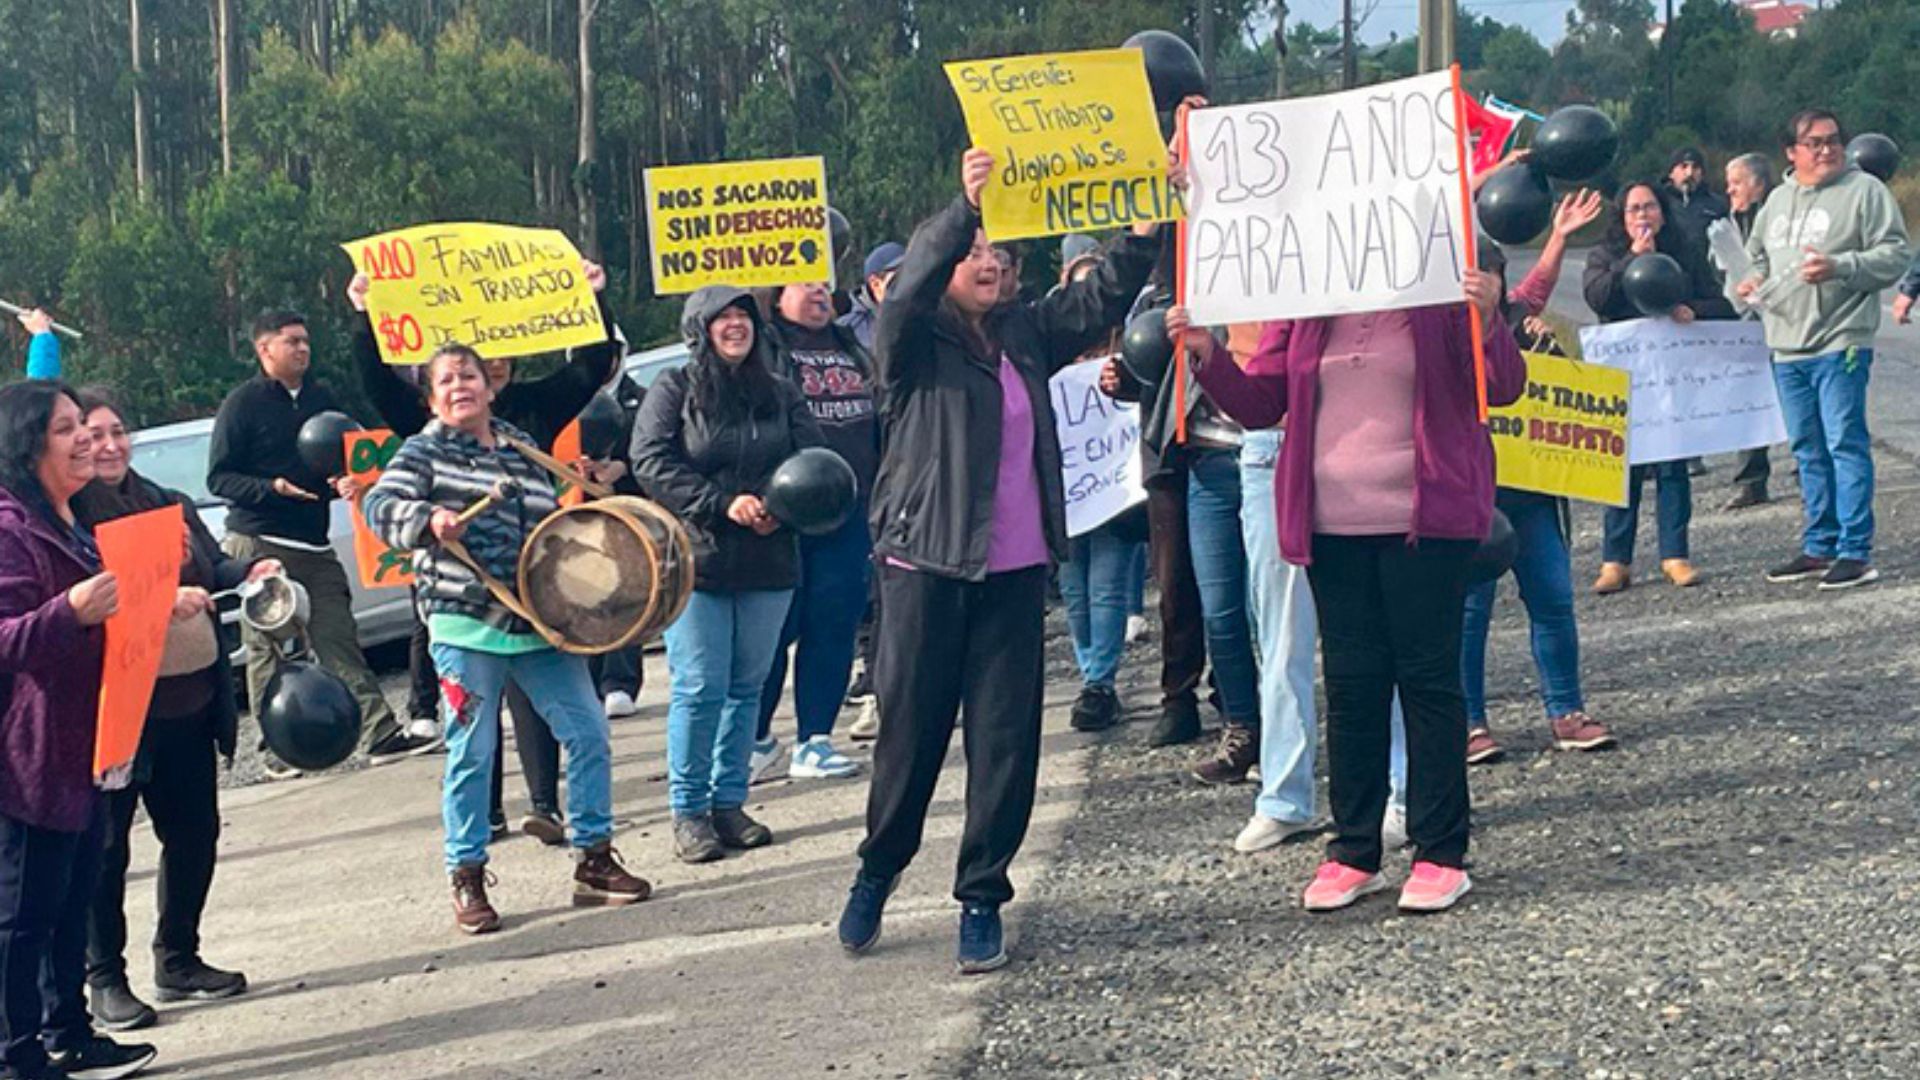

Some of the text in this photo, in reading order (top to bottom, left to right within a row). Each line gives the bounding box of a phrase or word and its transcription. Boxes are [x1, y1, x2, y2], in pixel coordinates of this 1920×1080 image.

[1204, 86, 1460, 204] 13 AÑOS
[658, 178, 817, 210] NOS SACARON
[667, 206, 825, 241] SIN DERECHOS
[1194, 185, 1462, 297] PARA NADA
[363, 234, 565, 280] 110 FAMILIAS
[661, 250, 697, 277] NO
[701, 246, 744, 272] SIN
[420, 268, 574, 308] SIN TRABAJO
[1060, 382, 1107, 427] LA
[1527, 381, 1549, 402] DE
[1551, 386, 1628, 418] TRABAJO
[1488, 416, 1625, 457] ERO RESPETO
